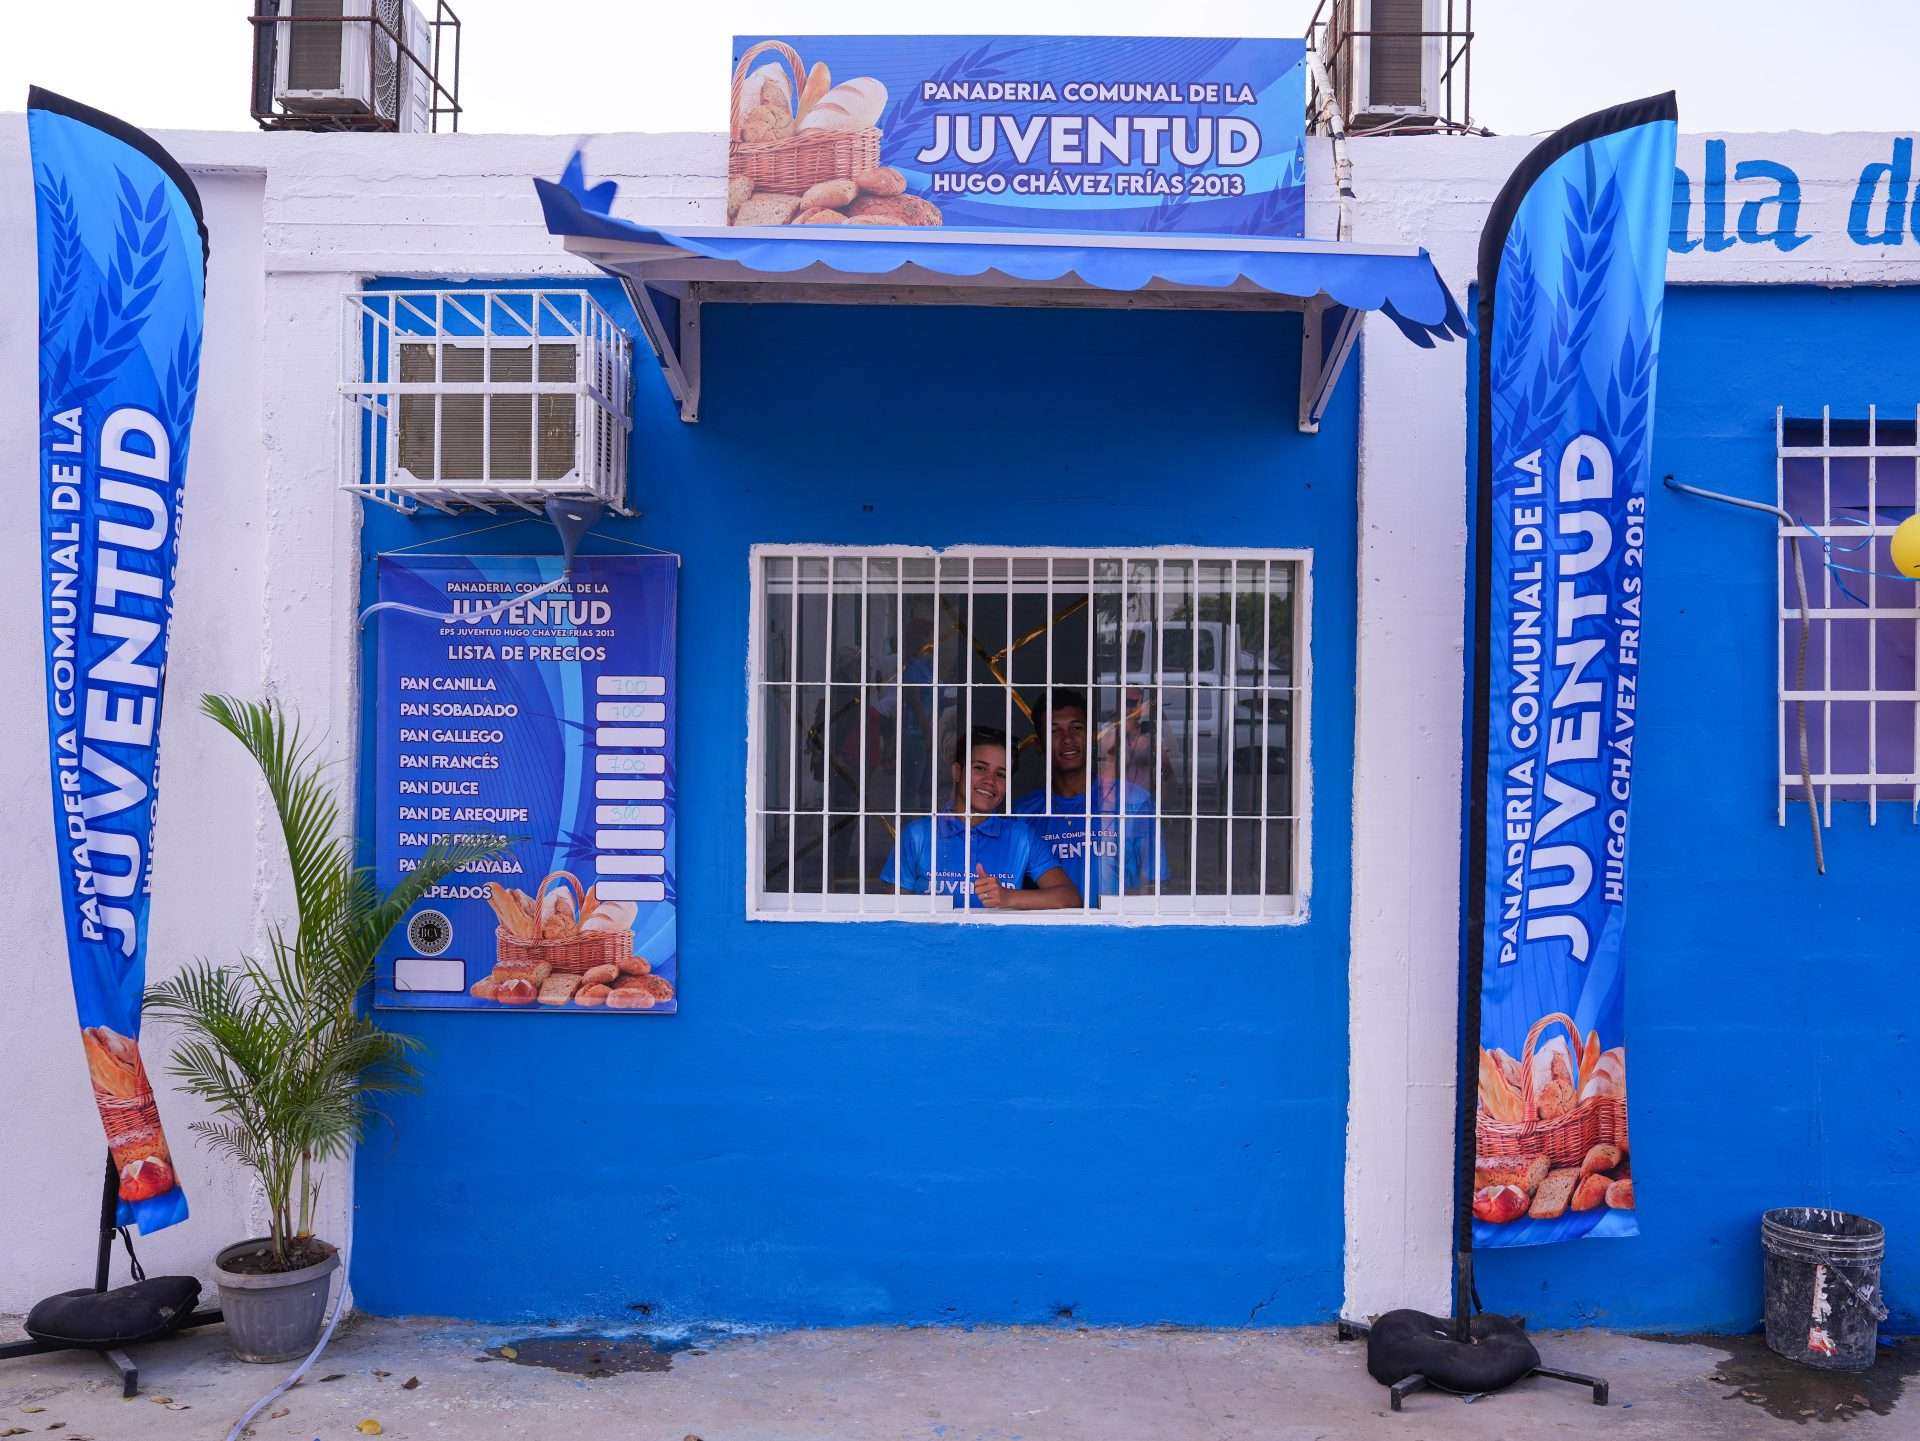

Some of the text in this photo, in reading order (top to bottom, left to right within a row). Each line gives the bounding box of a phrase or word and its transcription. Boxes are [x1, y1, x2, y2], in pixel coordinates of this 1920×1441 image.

[923, 82, 1255, 104] PANADERIA COMUNAL DE LA
[916, 116, 1261, 165] JUVENTUD
[934, 170, 1243, 195] HUGO CHÁVEZ FRÍAS 2013
[1847, 137, 1920, 246] d
[447, 583, 512, 593] PANADERIA
[577, 584, 591, 593] DE
[595, 584, 609, 593] LA
[444, 599, 612, 625] JUVENTUD
[440, 628, 455, 636] EPS
[457, 628, 502, 636] JUVENTUD
[503, 629, 530, 637] HUGO
[448, 645, 607, 661] LISTA DE PRECIOS
[49, 406, 104, 941] PANADERIA COMUNAL DE LA
[80, 407, 171, 958] JUVENTUD
[400, 677, 497, 691] PAN CANILLA
[1500, 448, 1544, 965] PANADERIA COMUNAL DE LA
[1525, 433, 1615, 962] JUVENTUD
[1605, 496, 1646, 905] HUGO CHÁVEZ FRÍAS 2013
[400, 703, 518, 718] PAN SOBADADO
[400, 729, 504, 743] PAN GALLEGO
[400, 753, 499, 769] PAN FRANCÉS
[400, 781, 479, 795] PAN DULCE
[399, 808, 528, 822] PAN DE AREQUIPE
[399, 833, 428, 846] PAN
